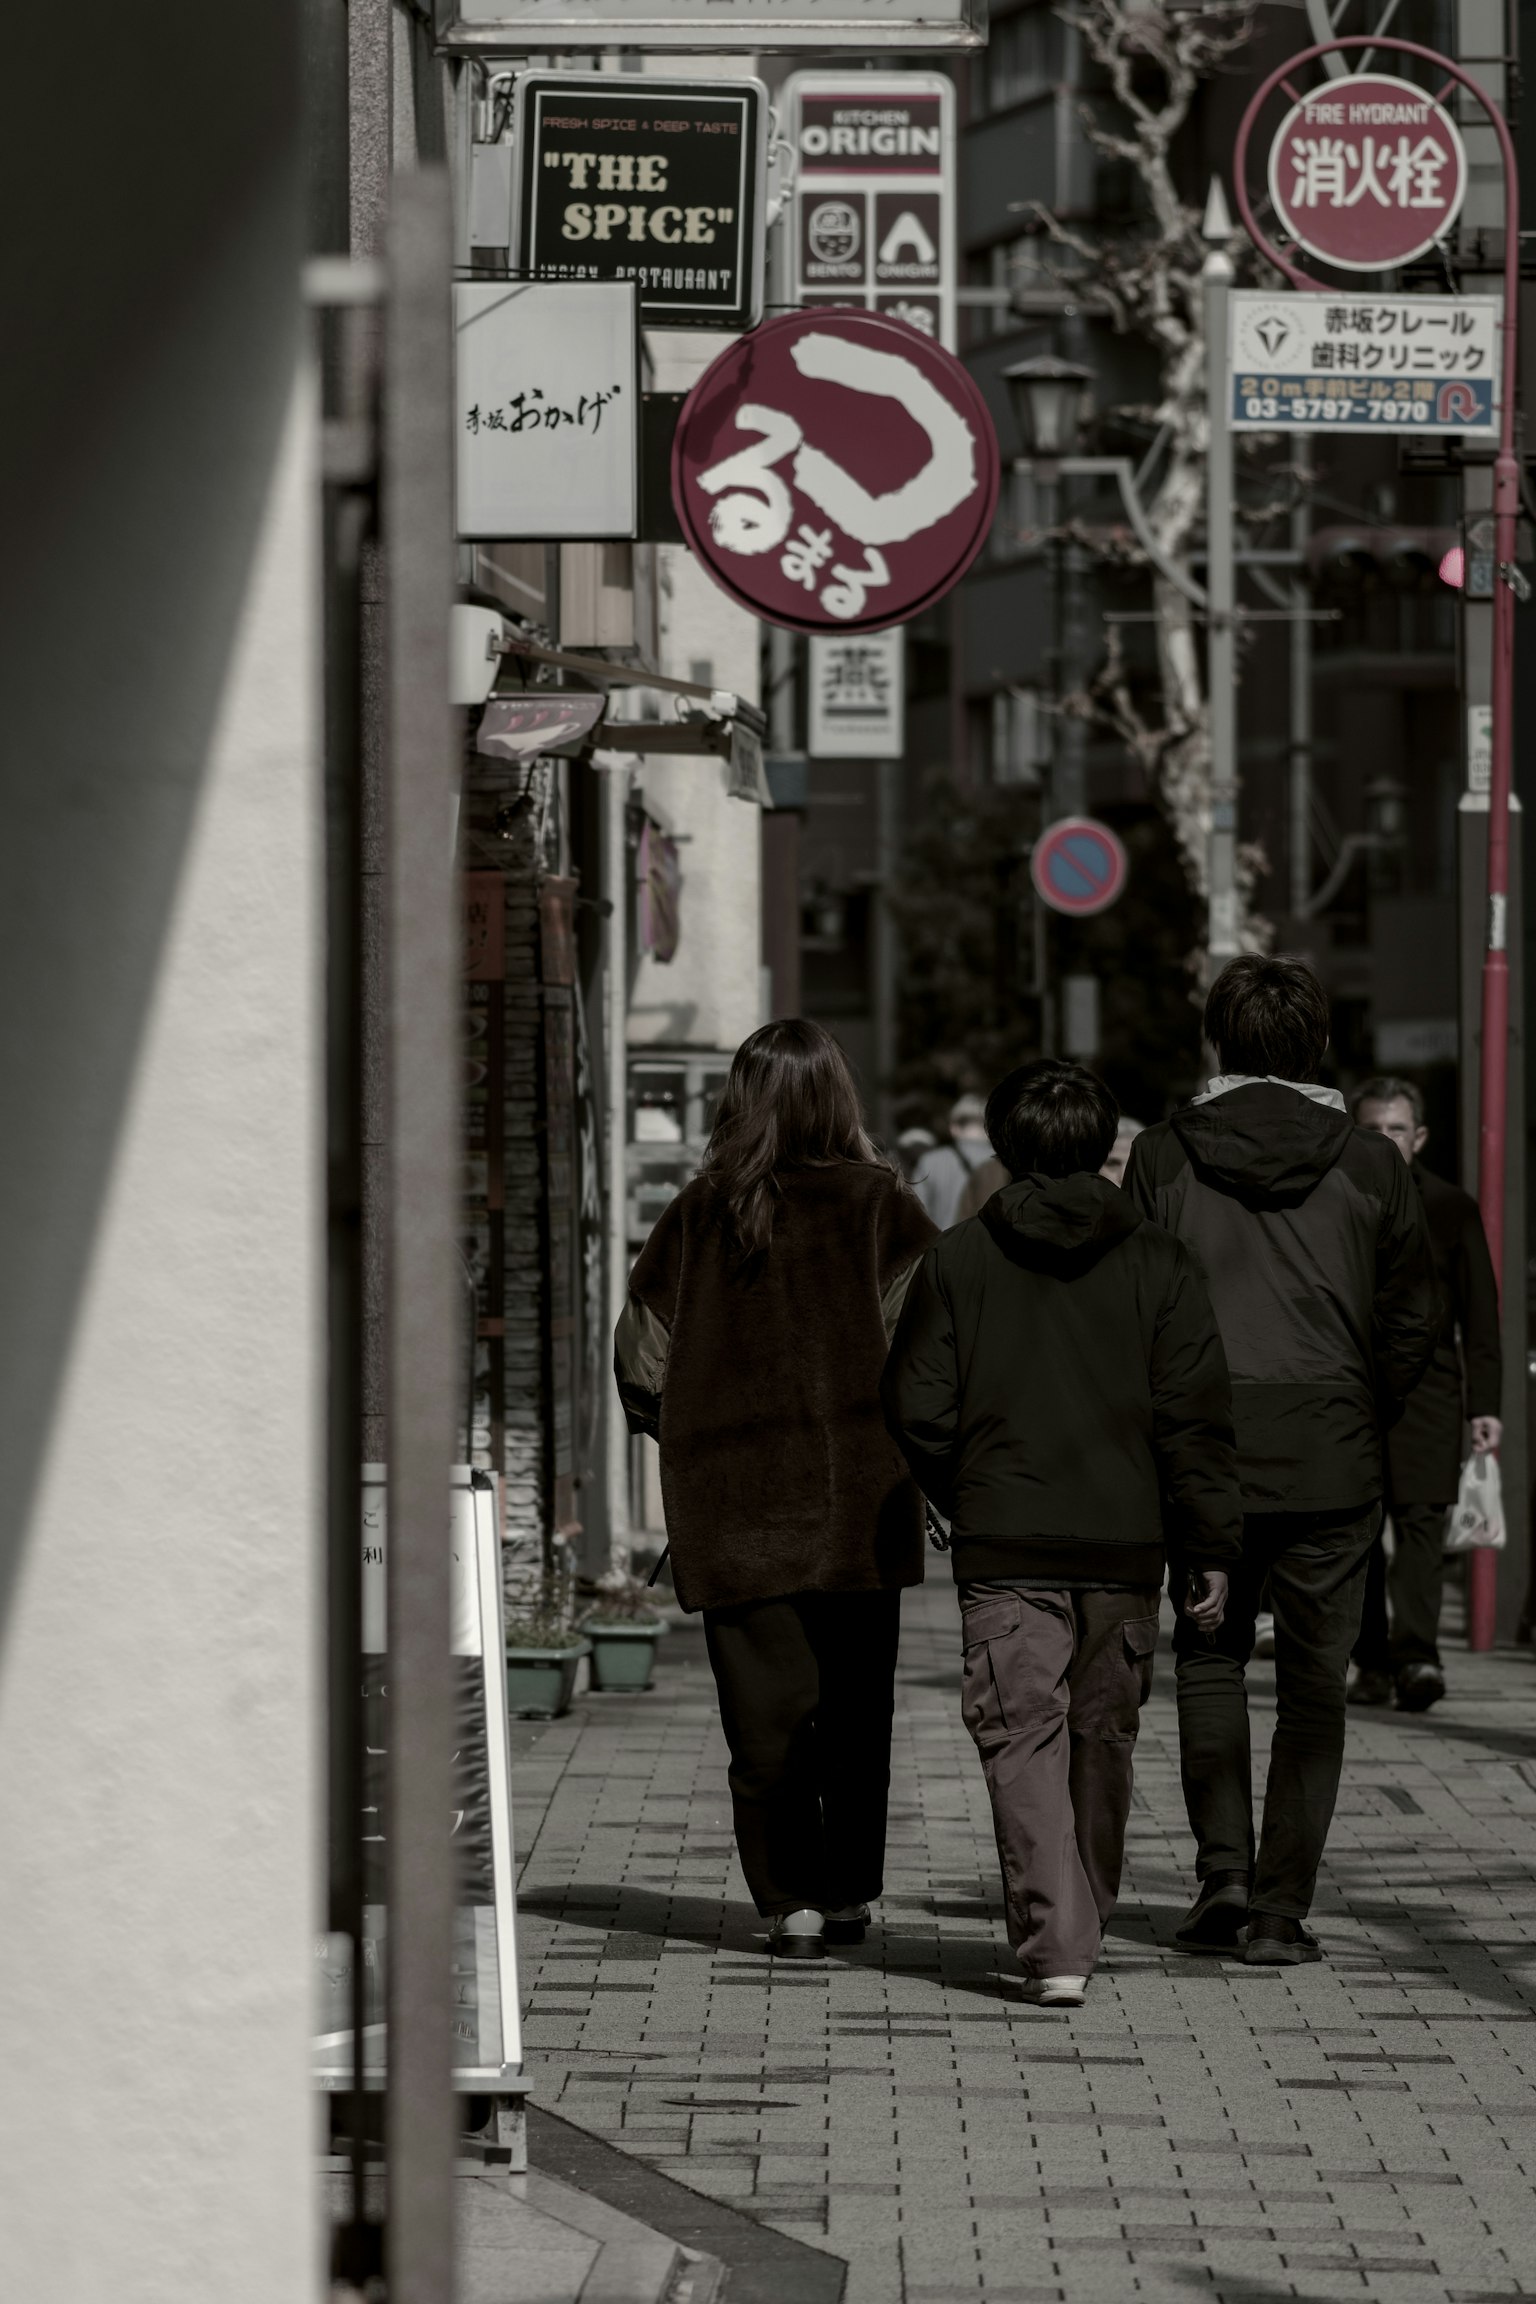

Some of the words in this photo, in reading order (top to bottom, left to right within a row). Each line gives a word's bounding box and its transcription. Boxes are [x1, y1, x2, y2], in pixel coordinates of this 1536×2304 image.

[543, 117, 588, 129] FRESH
[592, 118, 637, 131] SPICE
[653, 120, 690, 132] DEEP
[694, 121, 738, 134] TASTE
[833, 110, 909, 125] KITCHEN
[1305, 103, 1345, 125] FIRE
[1349, 103, 1429, 125] HYDRANT
[800, 125, 941, 156] ORIGIN
[543, 151, 669, 192] "THE
[1290, 136, 1449, 208] 消火栓
[561, 202, 734, 244] SPICE"
[806, 262, 862, 278] BENTO
[1325, 306, 1475, 335] 赤坂クレール
[1311, 341, 1486, 371] 歯科クリニック
[1245, 397, 1429, 422] 03-5797-7970
